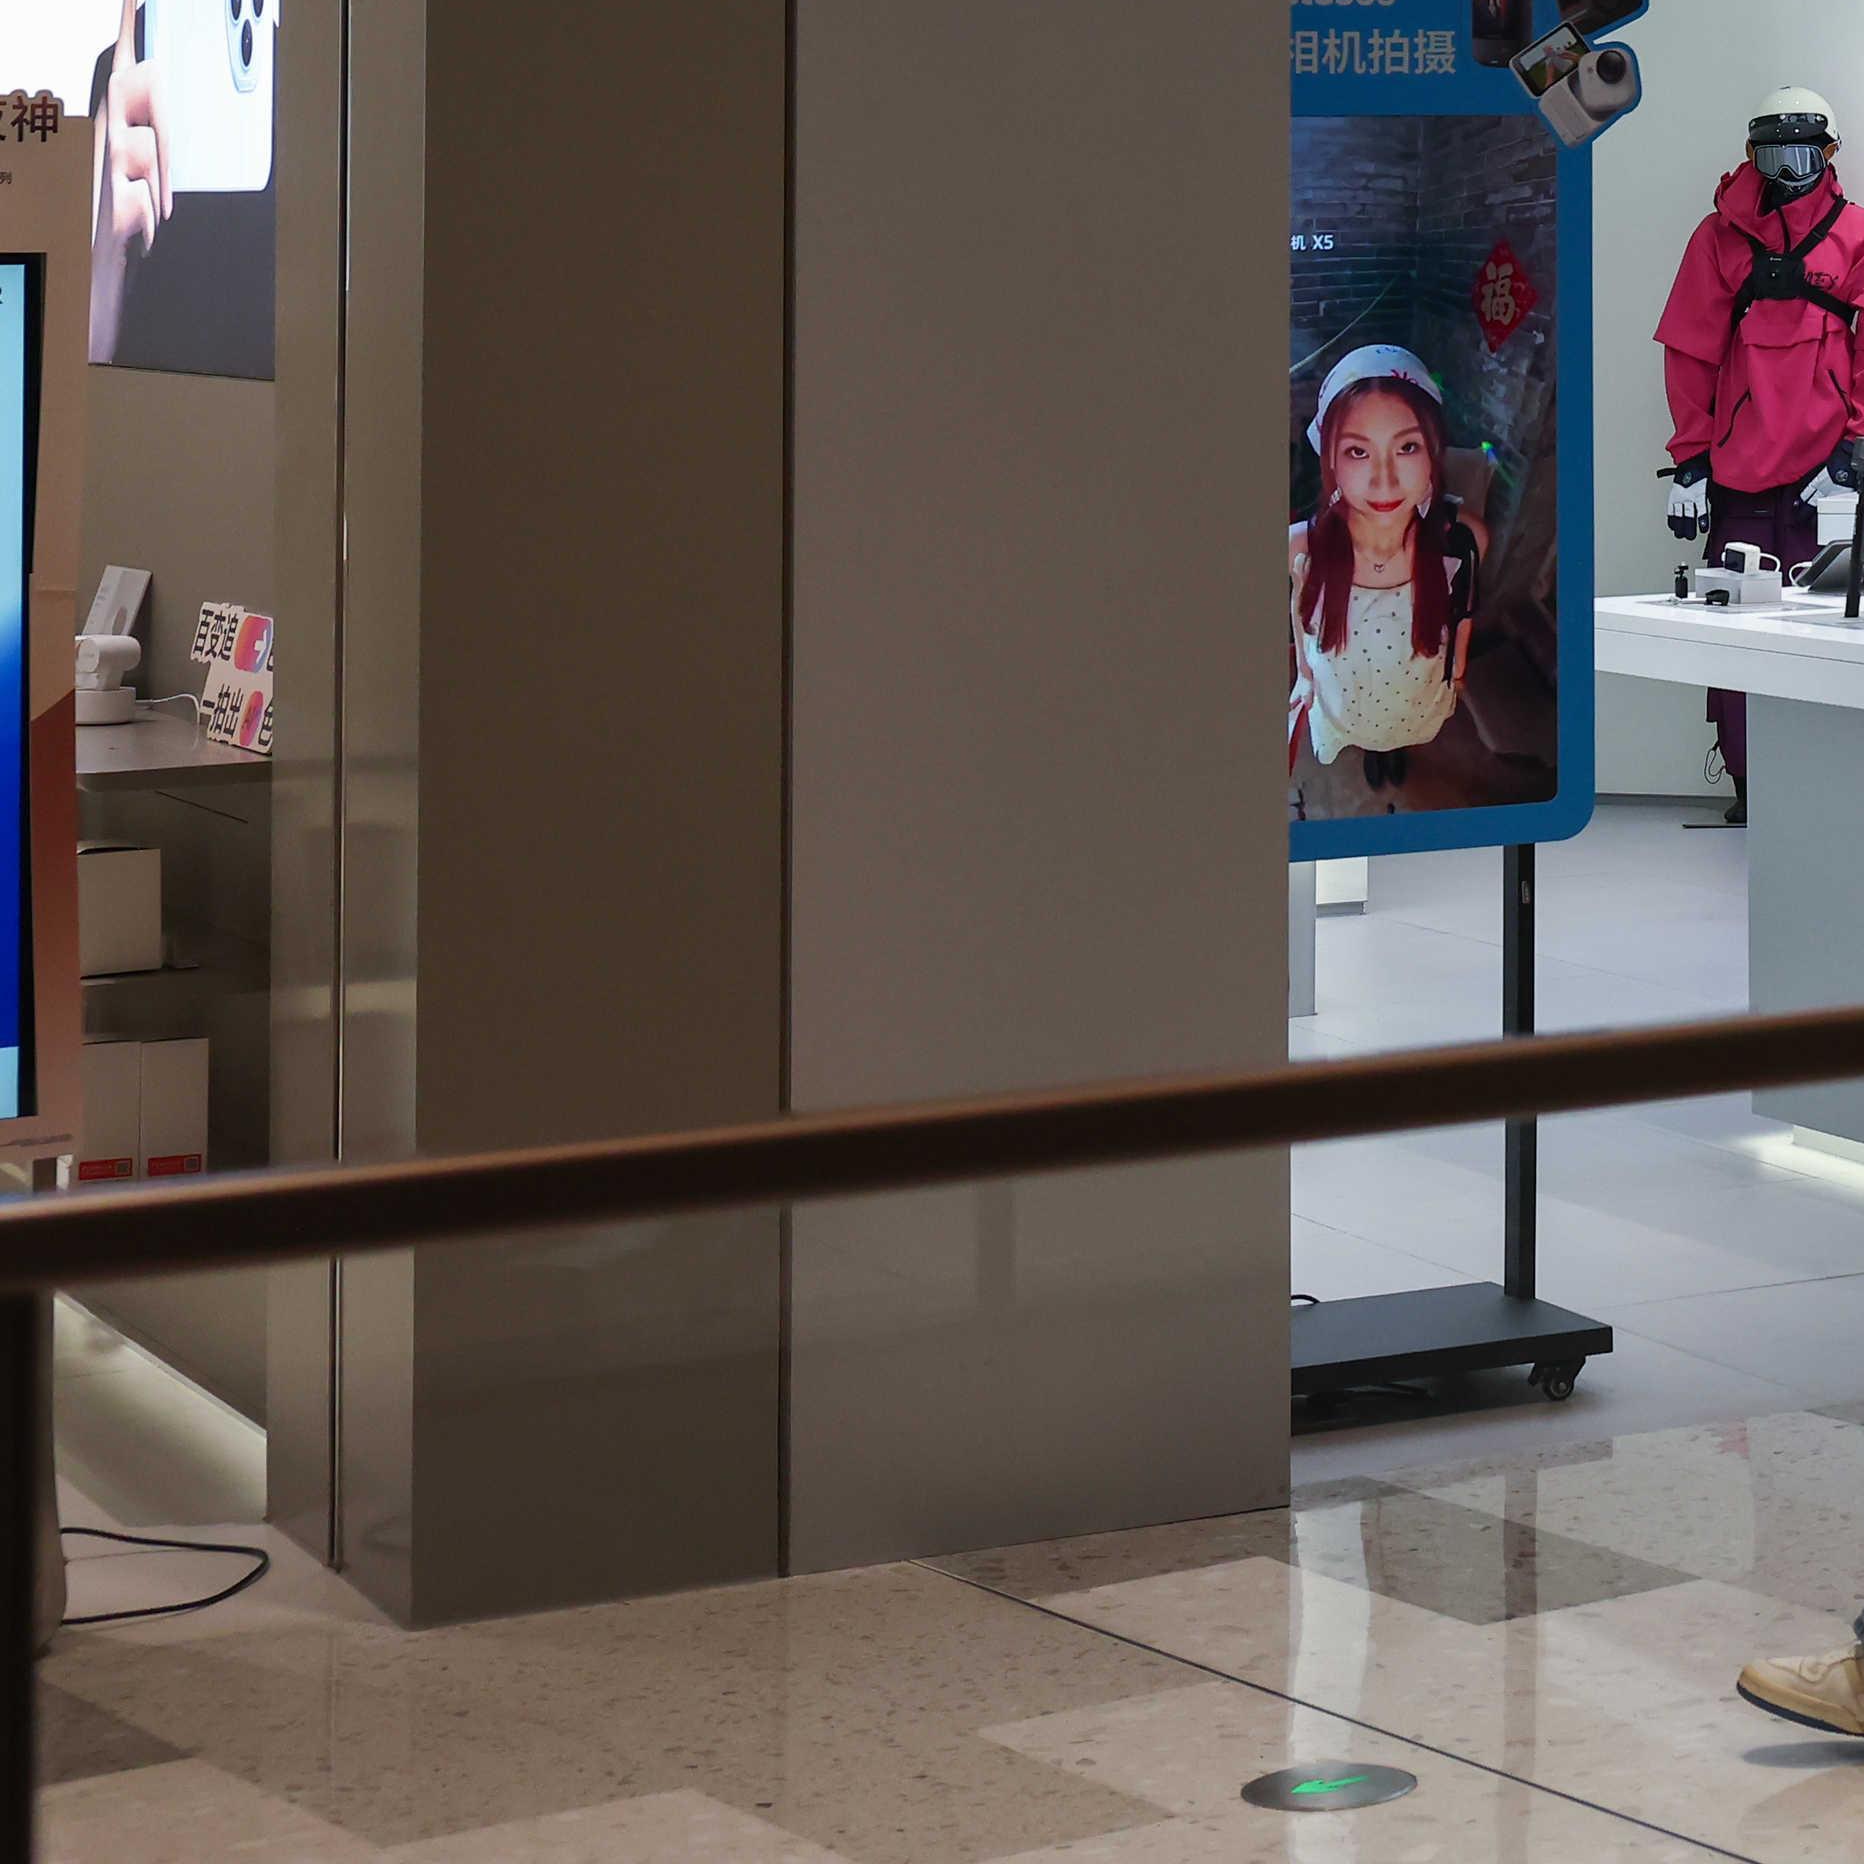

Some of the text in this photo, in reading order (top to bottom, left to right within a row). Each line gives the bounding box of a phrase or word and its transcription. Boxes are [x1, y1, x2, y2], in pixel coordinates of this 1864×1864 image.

[0, 96, 59, 142] 神
[1312, 235, 1334, 250] X5
[1481, 262, 1516, 326] 福
